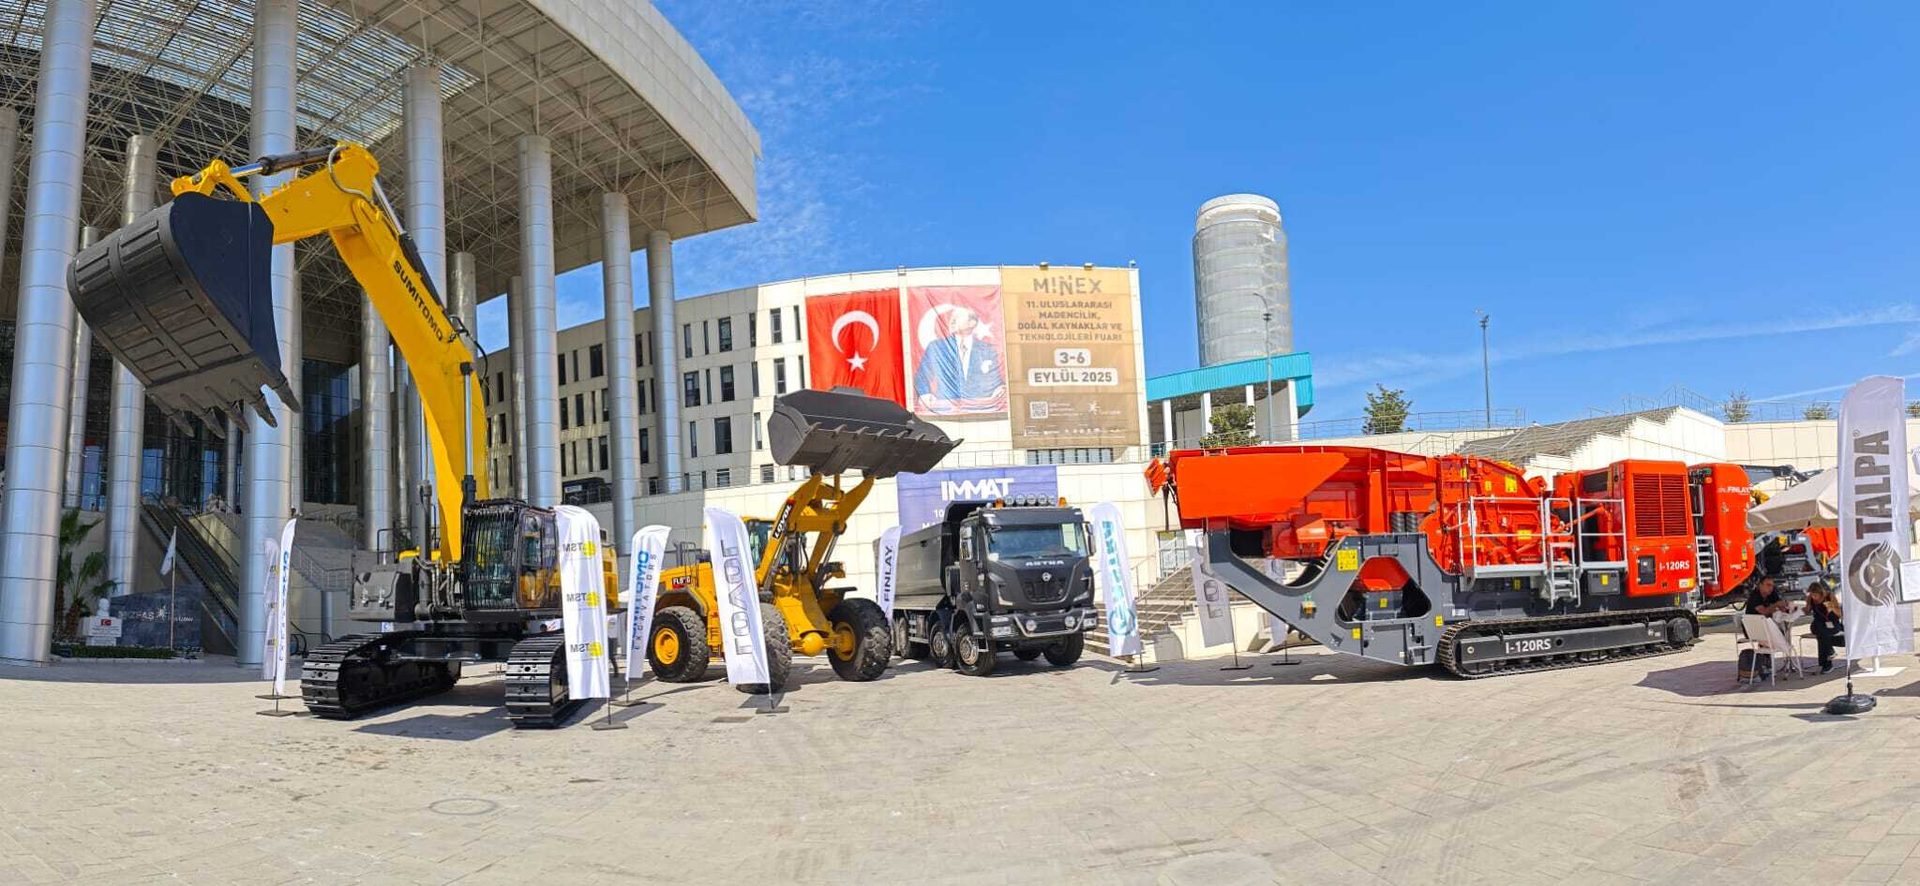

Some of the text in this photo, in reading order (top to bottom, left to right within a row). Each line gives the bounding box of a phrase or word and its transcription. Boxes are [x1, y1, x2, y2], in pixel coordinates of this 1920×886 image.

[1033, 275, 1102, 295] MINEX
[393, 260, 443, 341] SUMITOMO
[1026, 301, 1113, 309] 11. ULUSLARARASI
[1018, 320, 1123, 331] DOĞAL KAYNAKLAR VE
[1019, 331, 1122, 341] TEKNOLOJİLERİ FUARI
[1059, 351, 1086, 364] 3-6
[1034, 369, 1113, 383] EYLÜL 2025
[940, 478, 1015, 500] IMMAT
[1854, 431, 1893, 540] TALPA
[774, 504, 793, 539] LOVOL
[1659, 560, 1690, 571] I-120RS
[884, 546, 893, 602] FINLAY
[1505, 639, 1551, 653] I-120RS
